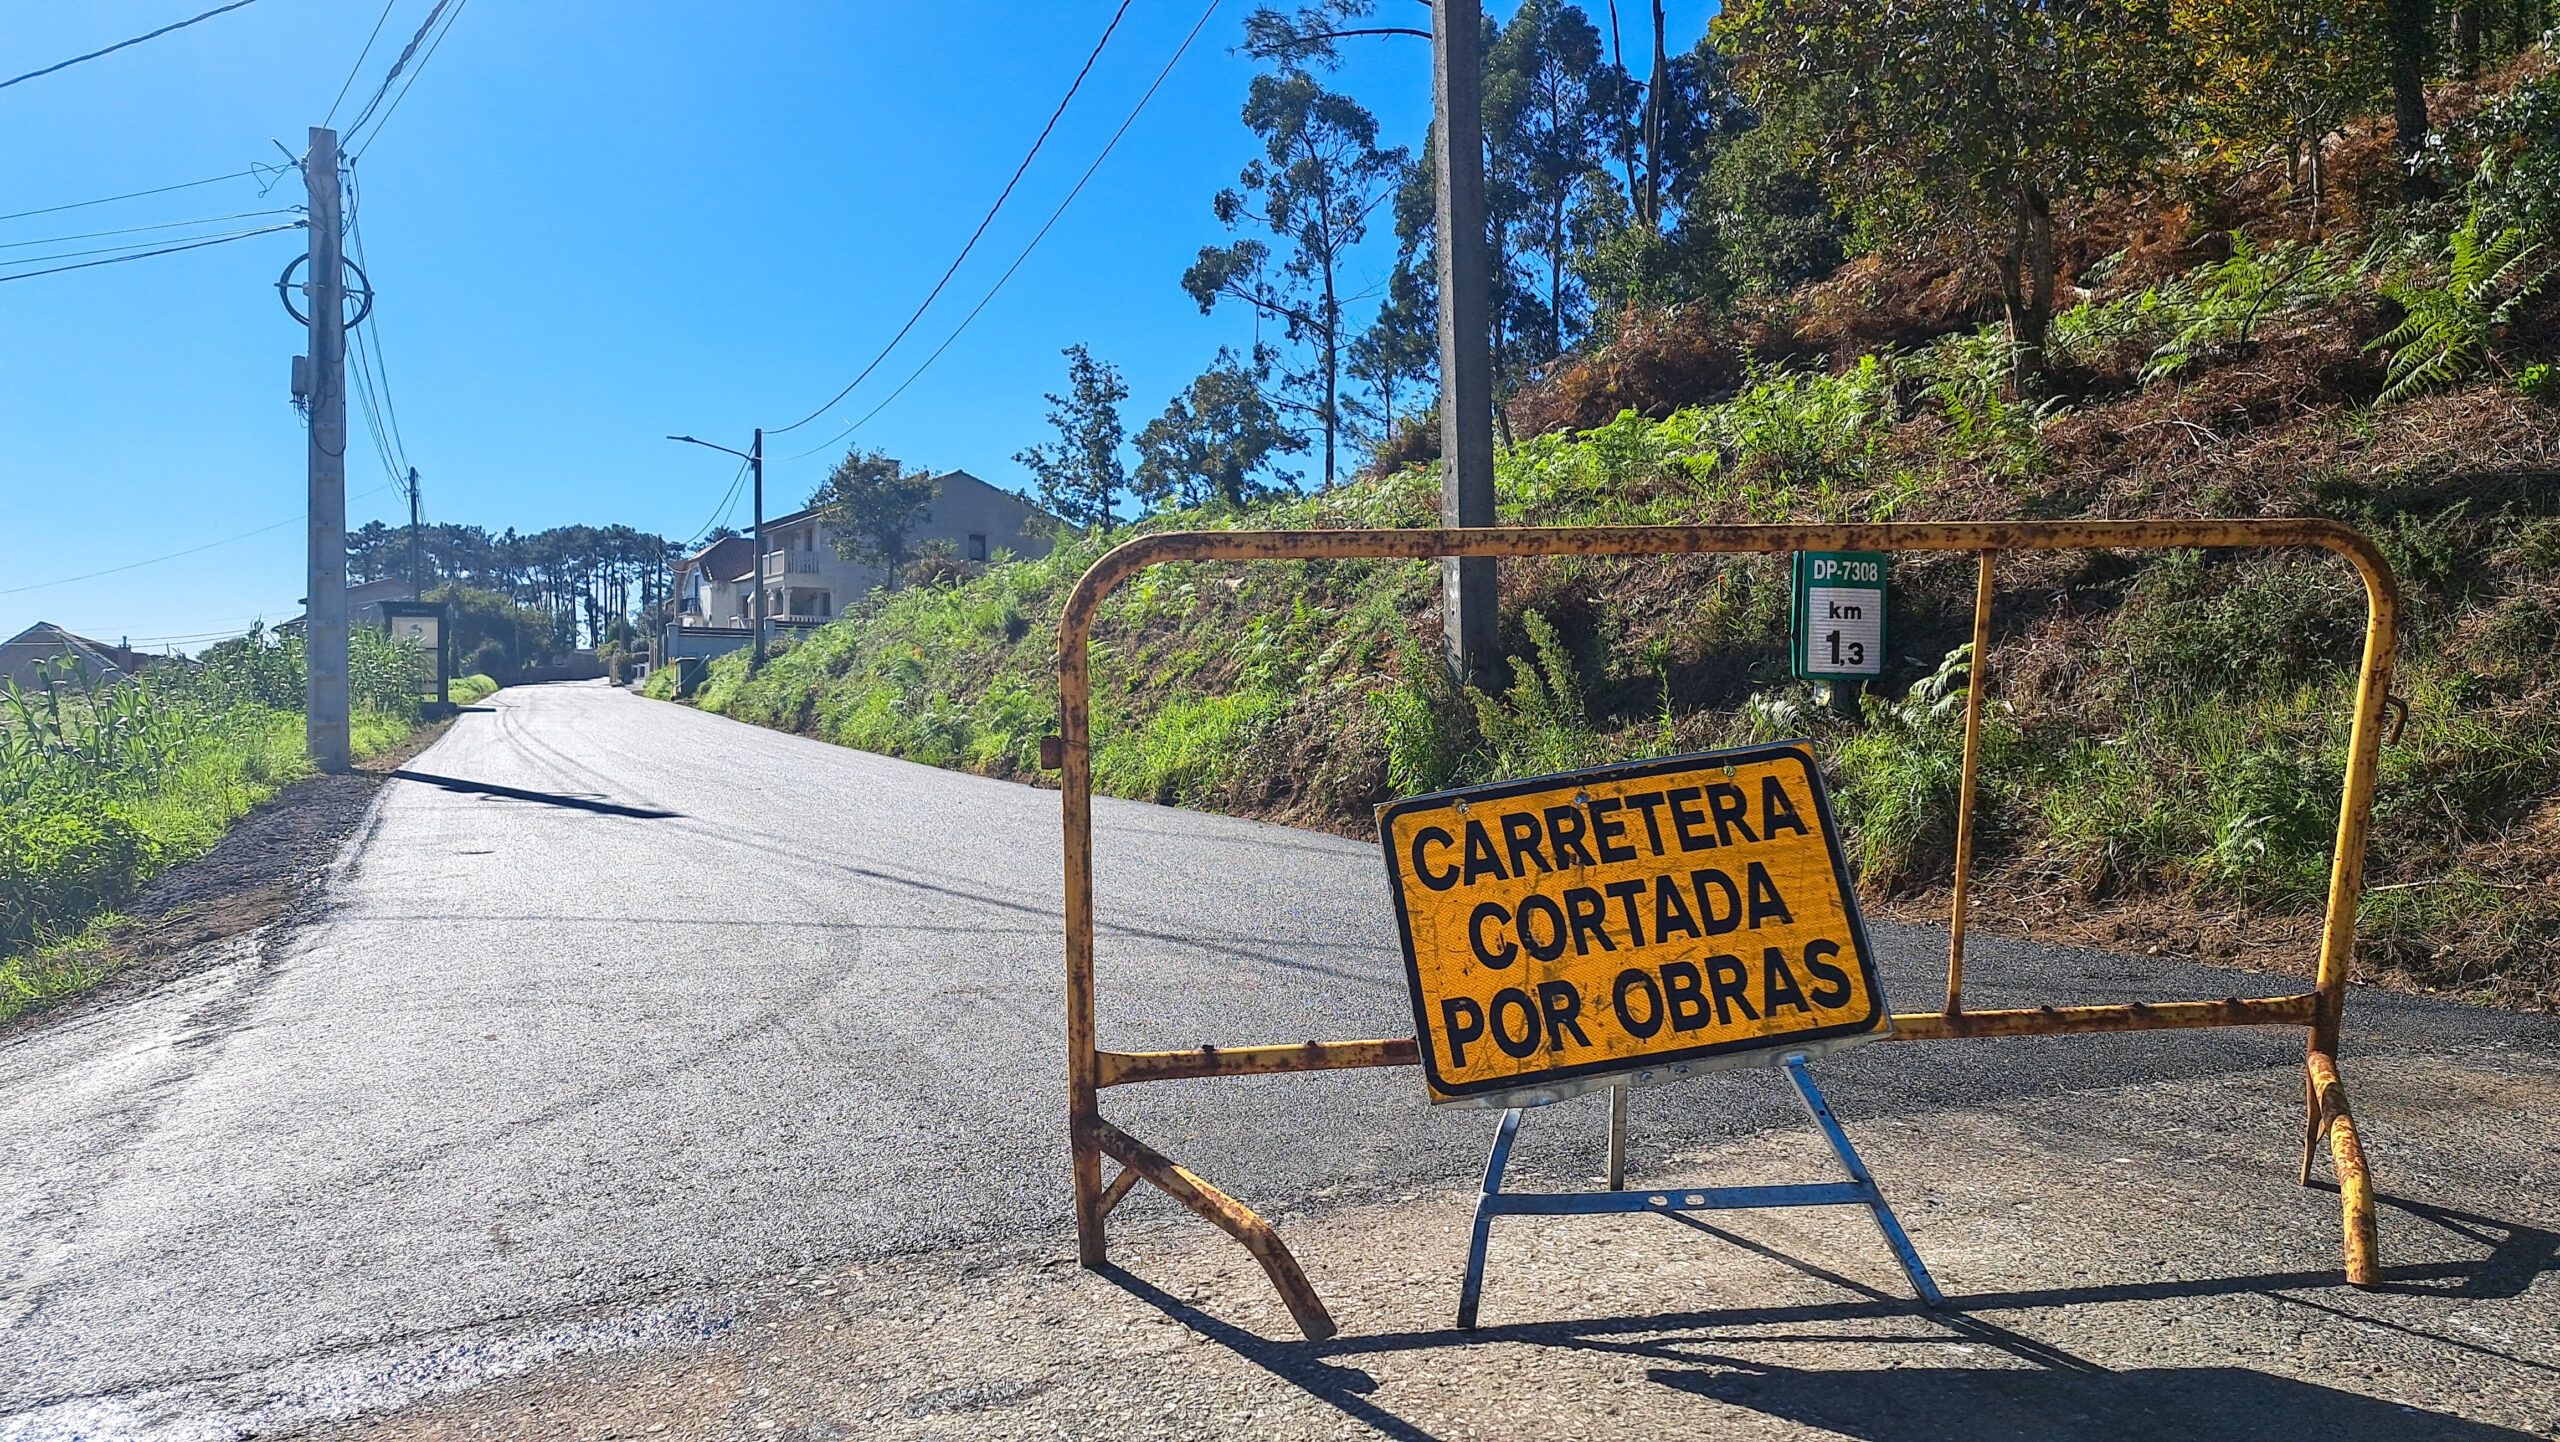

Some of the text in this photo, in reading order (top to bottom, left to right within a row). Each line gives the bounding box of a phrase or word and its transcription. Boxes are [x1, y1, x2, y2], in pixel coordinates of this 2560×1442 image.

[1813, 559, 1878, 582] DP-7308
[1828, 601, 1862, 619] km
[1411, 775, 1808, 891] CARRETERA
[1469, 861, 1794, 970] CORTADA
[1441, 939, 1852, 1069] POR OBRAS
